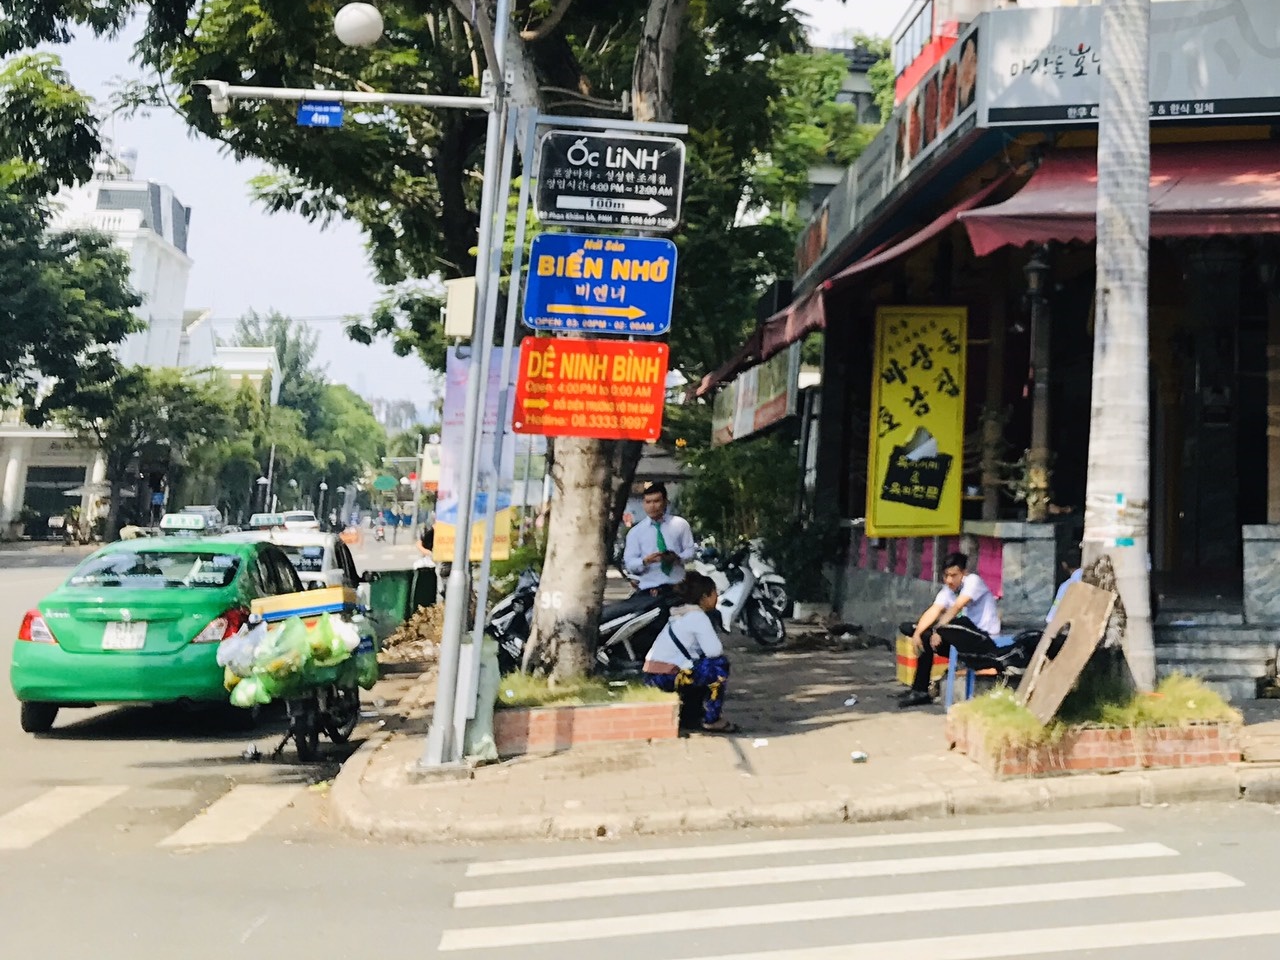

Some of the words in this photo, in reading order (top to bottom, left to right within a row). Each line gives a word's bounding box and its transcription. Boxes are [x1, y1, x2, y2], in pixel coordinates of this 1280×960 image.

[311, 112, 330, 124] 4m
[567, 137, 600, 166] Ốc
[610, 183, 624, 193] PM
[658, 186, 673, 197] AM
[537, 249, 603, 279] BIỂN
[611, 256, 670, 283] NHỚ
[527, 344, 556, 379] DÊ
[559, 352, 608, 381] NINH
[611, 349, 660, 383] BÌNH
[541, 591, 562, 610] 96
